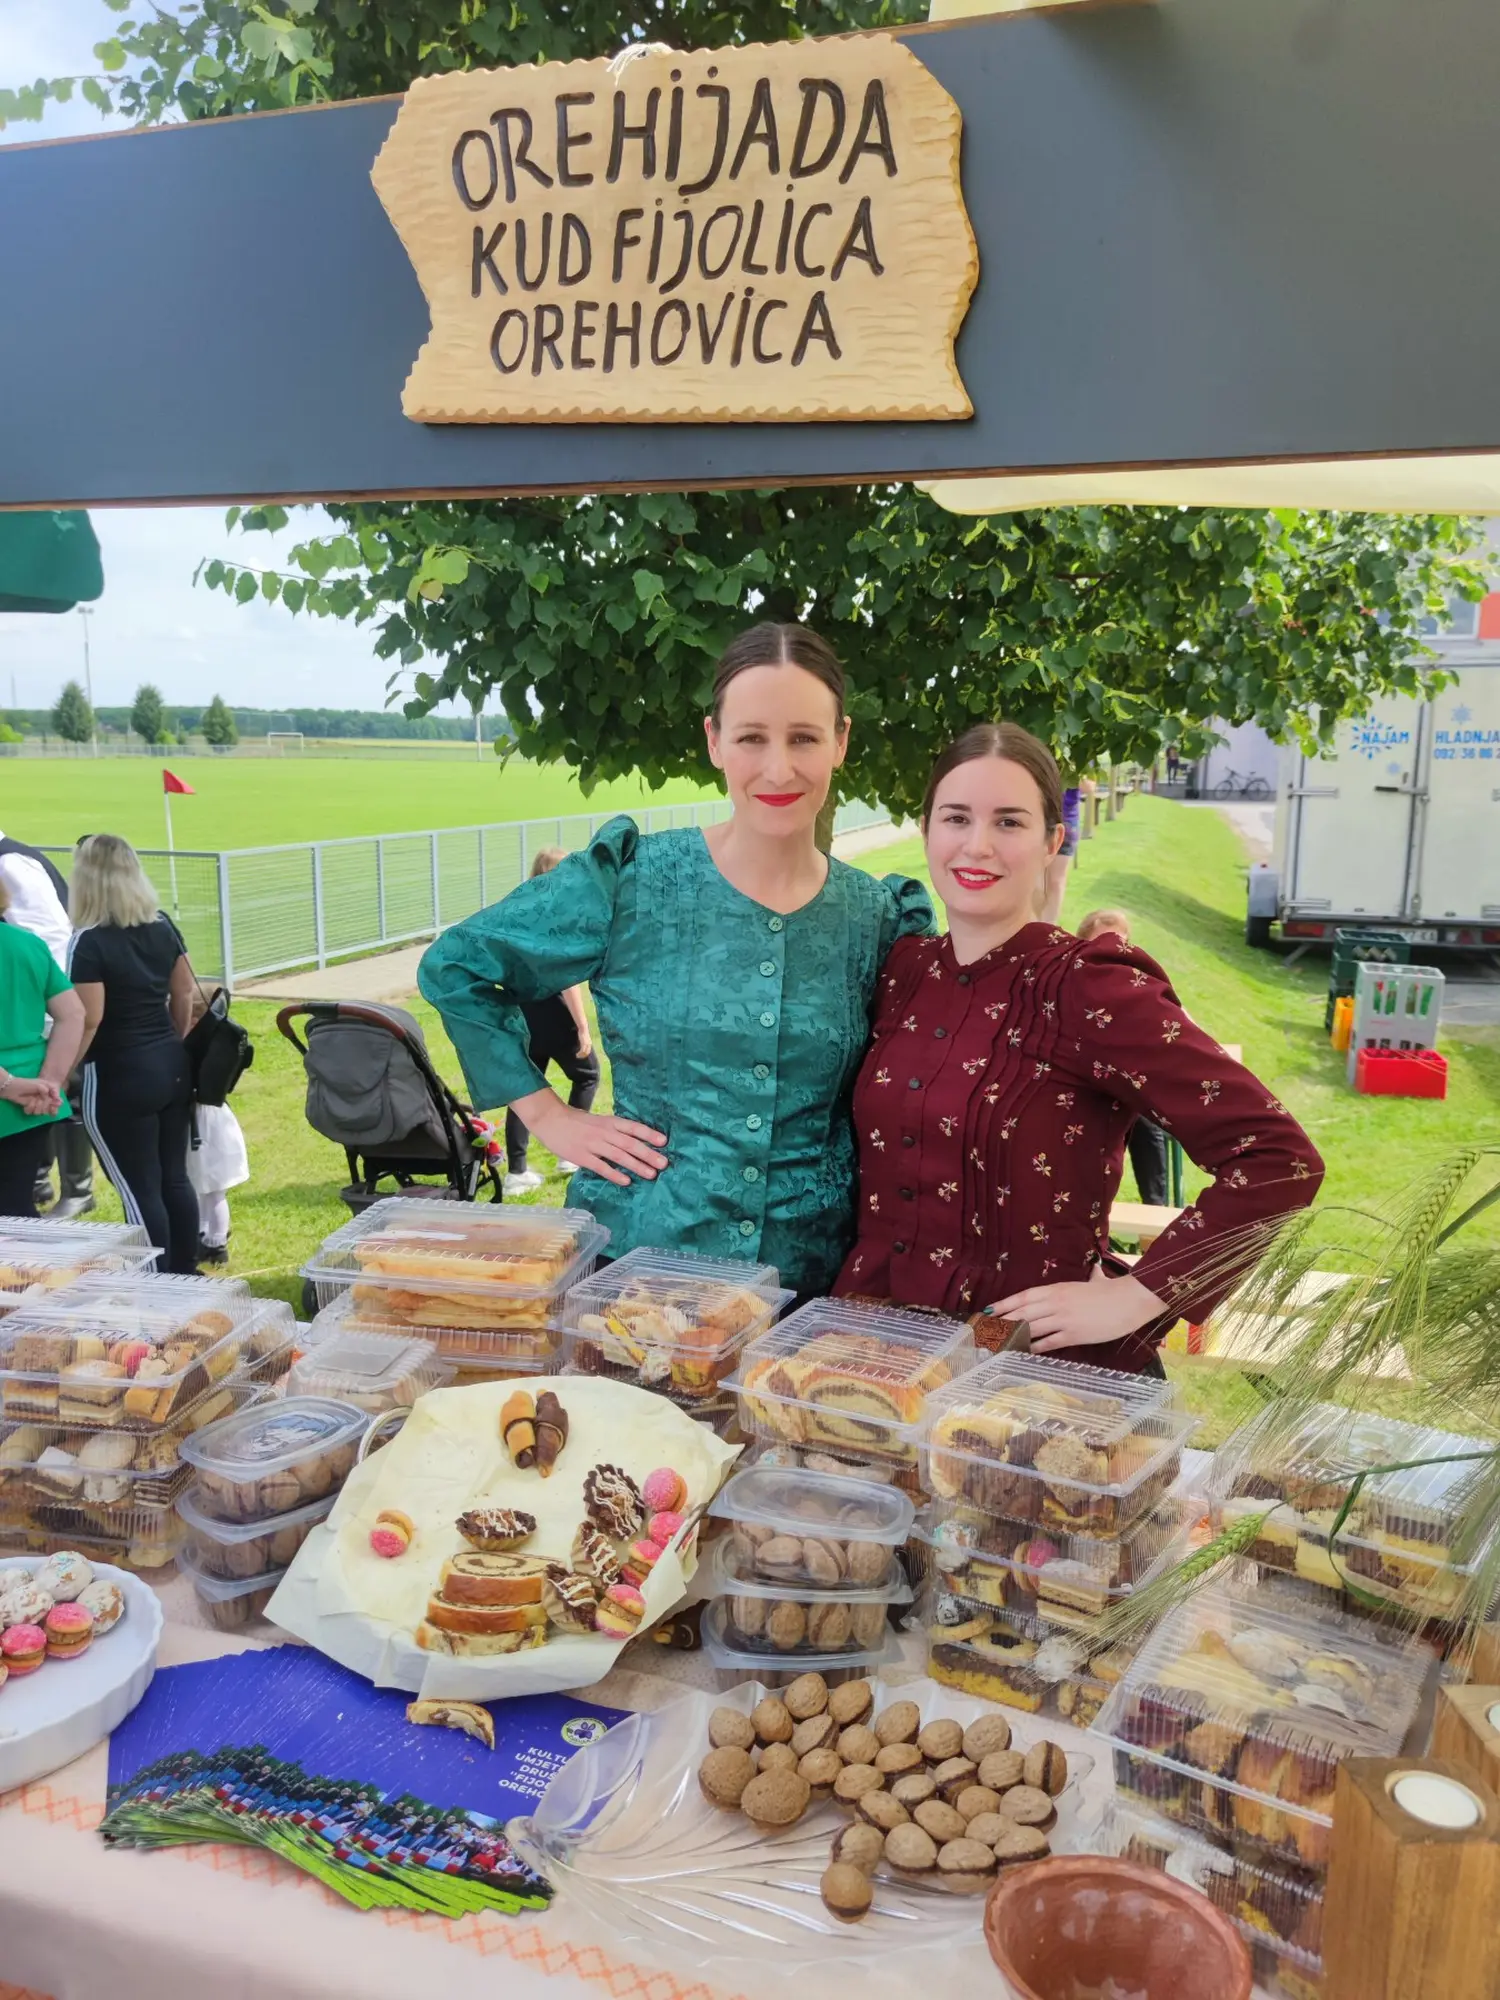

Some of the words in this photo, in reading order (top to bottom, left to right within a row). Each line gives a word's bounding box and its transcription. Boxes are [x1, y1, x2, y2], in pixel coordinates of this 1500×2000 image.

[470, 211, 592, 298] KUD
[612, 184, 886, 294] FIJOLICA
[490, 286, 843, 377] OREHOVICA
[1361, 731, 1410, 744] NAJAM
[1435, 730, 1500, 744] HLADNJA
[515, 1753, 562, 1771] UMJET
